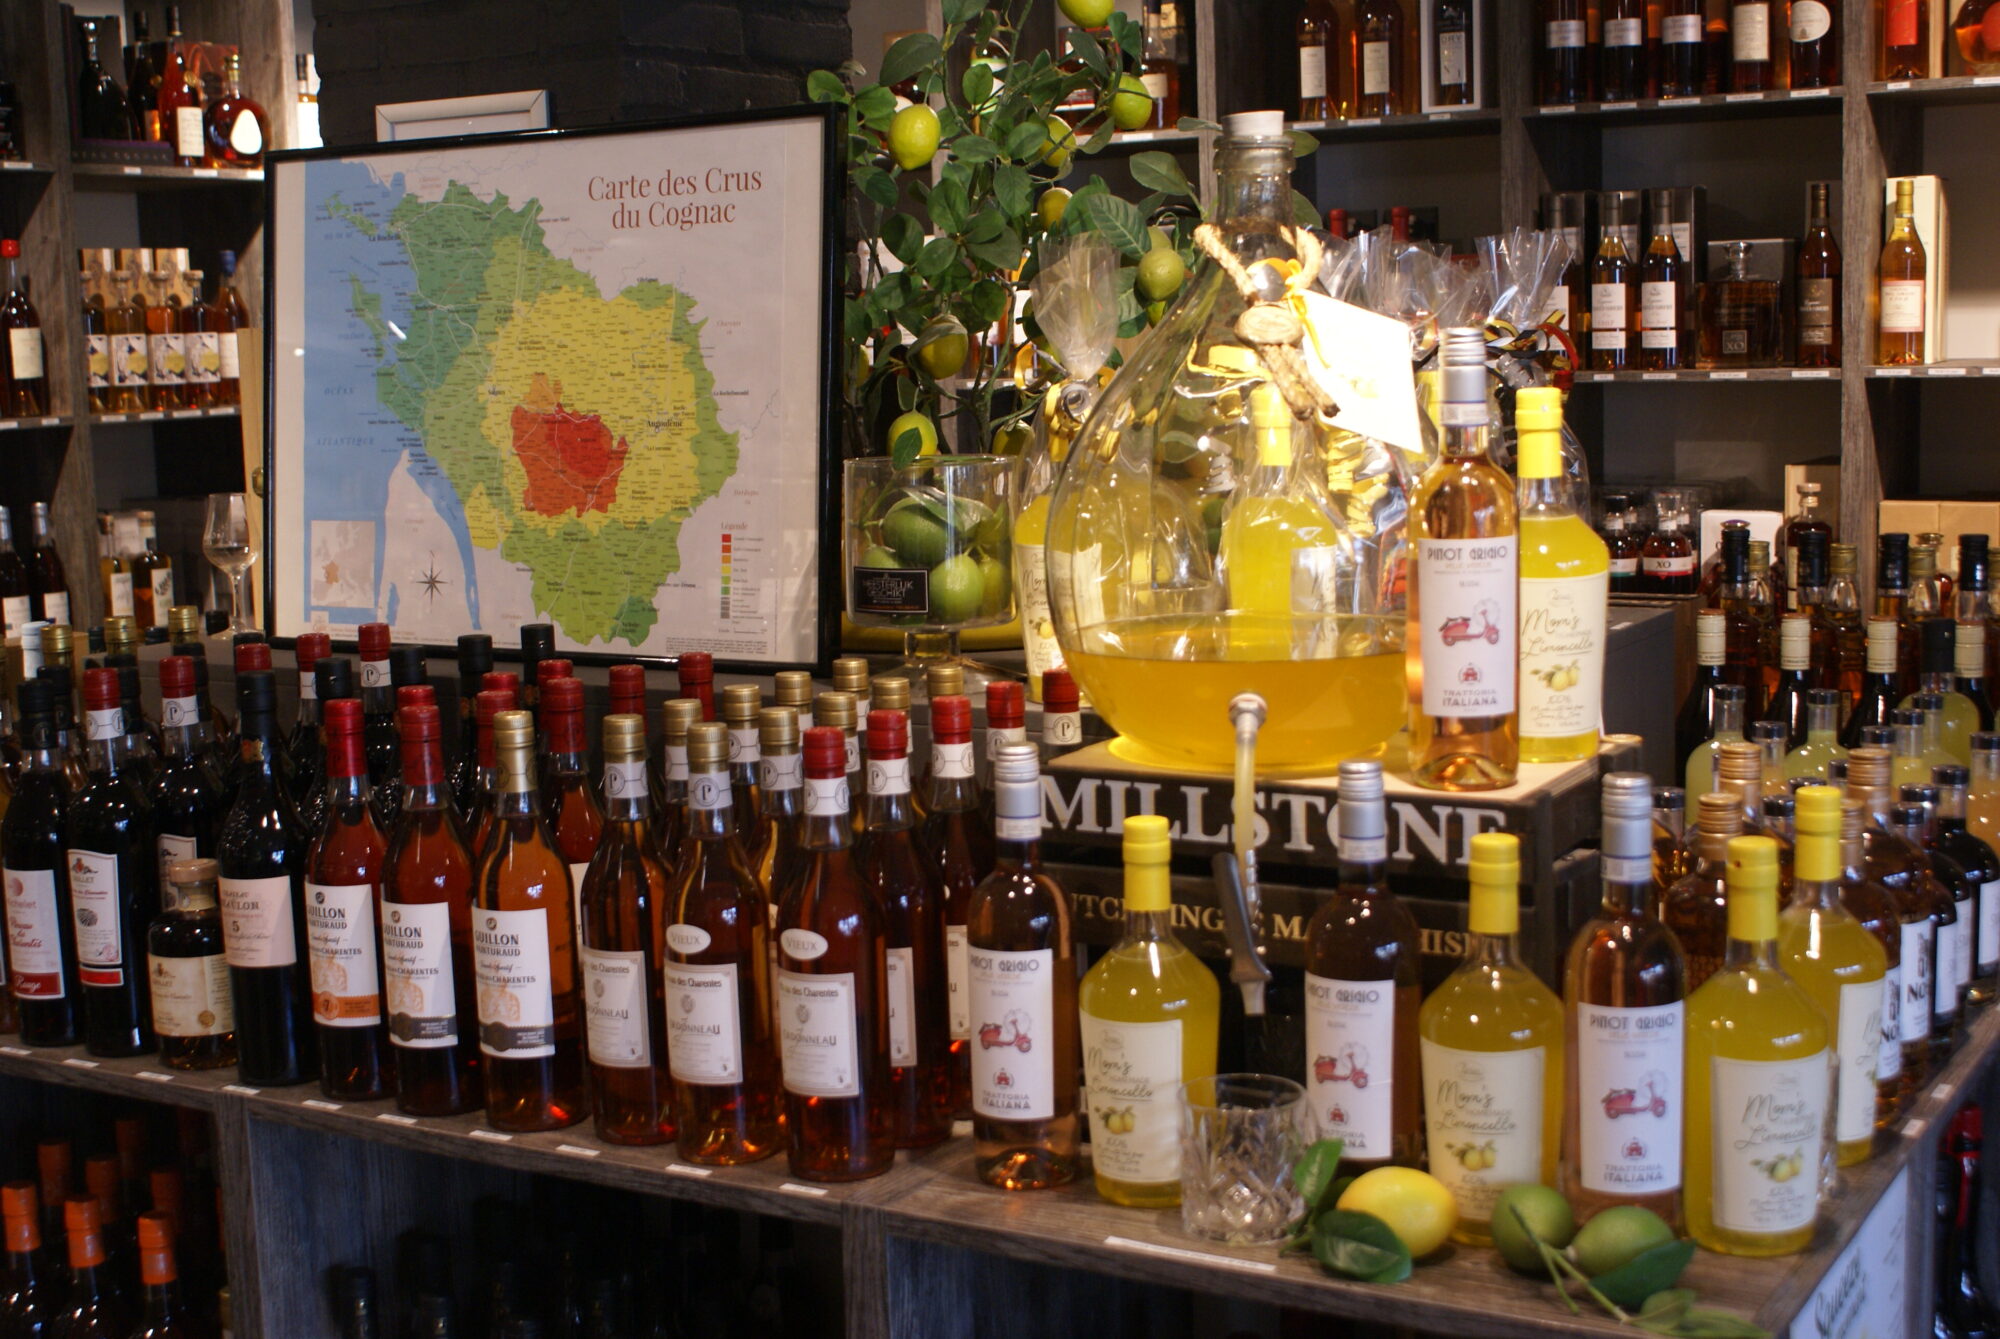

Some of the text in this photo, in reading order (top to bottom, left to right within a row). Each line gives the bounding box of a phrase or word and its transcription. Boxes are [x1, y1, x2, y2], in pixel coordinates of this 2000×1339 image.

[587, 167, 763, 201] Carte des Crus
[611, 200, 737, 232] du Cognac
[1427, 545, 1508, 561] PINOT GRIGIO
[1655, 560, 1672, 569] XO
[1521, 607, 1581, 635] Mom's
[1519, 634, 1595, 661] Limoncello
[1441, 697, 1498, 707] ITALIANA
[1037, 774, 1508, 865] MILLSTNE
[232, 919, 240, 933] 5
[671, 932, 701, 946] VIEUX
[785, 936, 818, 952] VIEUX
[998, 958, 1040, 972] GRIGIO
[688, 976, 722, 989] Charentes
[803, 985, 839, 998] Charentes
[1589, 1013, 1629, 1030] PINOT
[1436, 1078, 1496, 1109] Mom's
[1741, 1090, 1807, 1124] Mom's
[1433, 1108, 1518, 1132] Limoncello
[1603, 1171, 1664, 1183] ITALIANA
